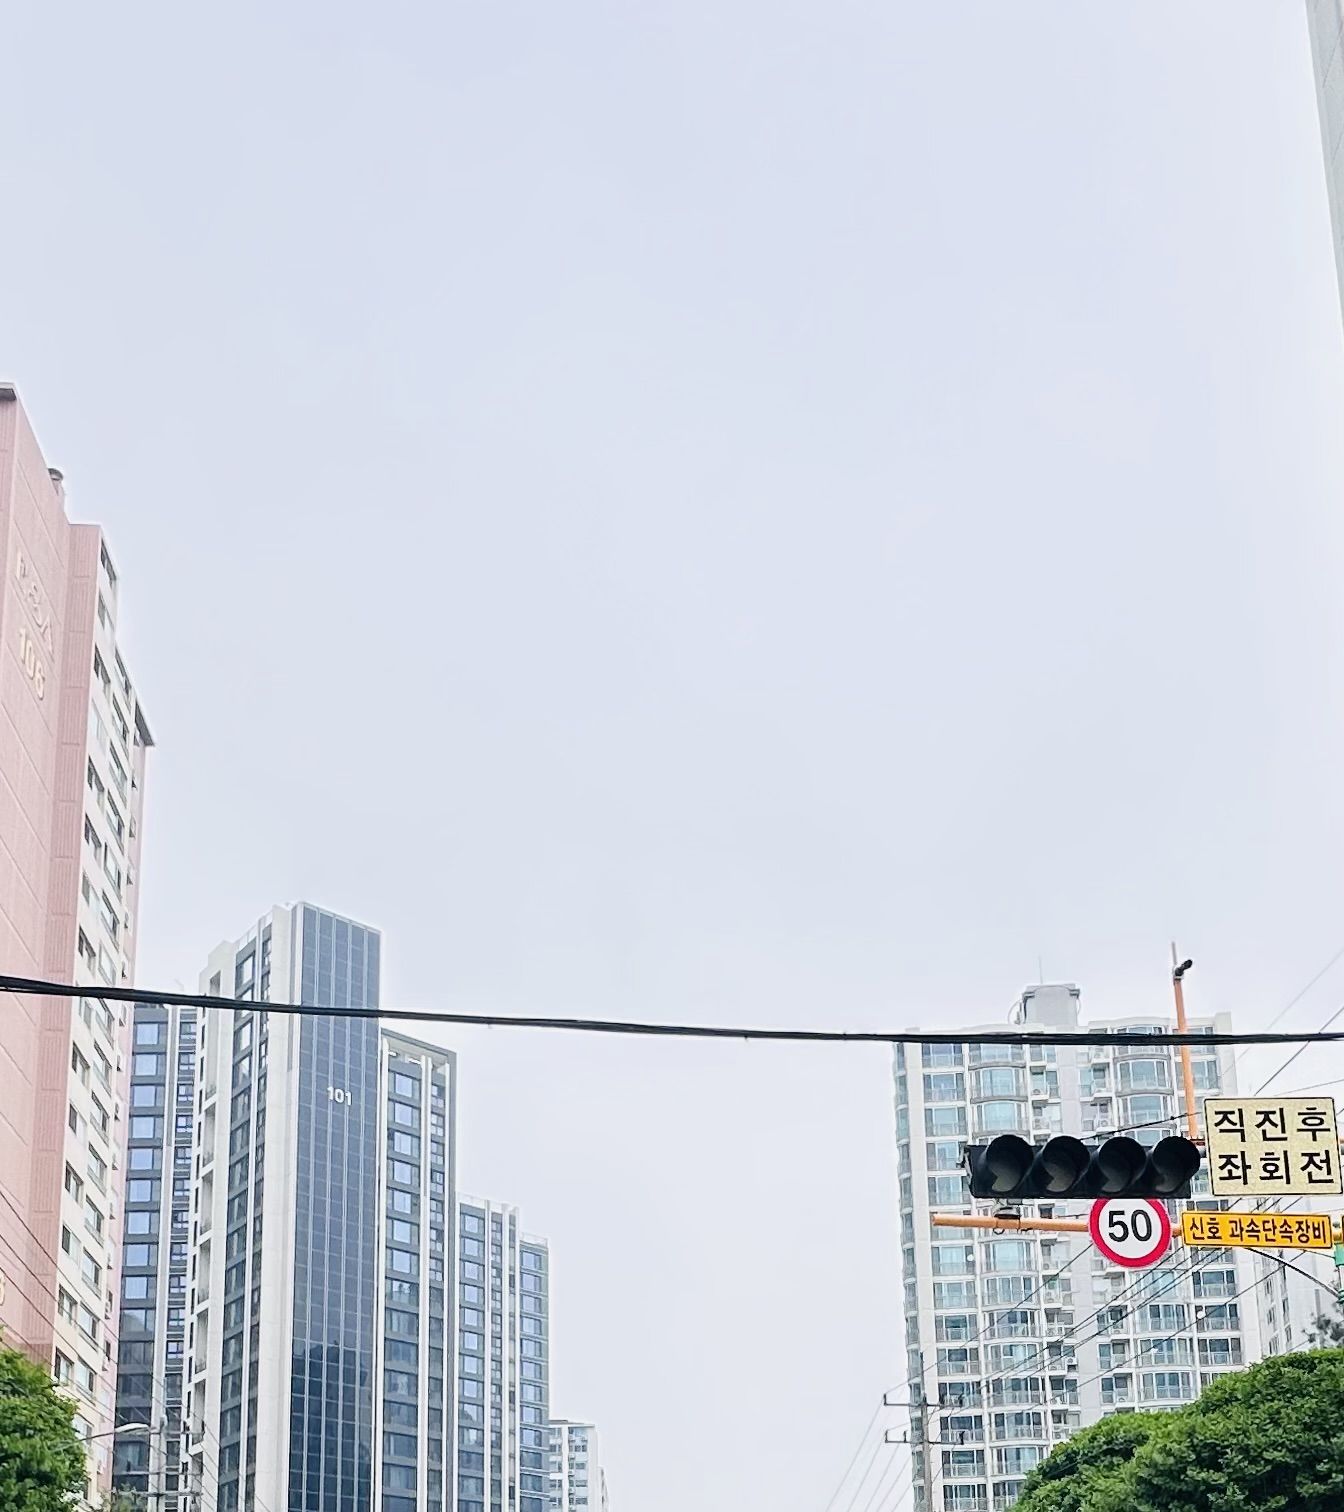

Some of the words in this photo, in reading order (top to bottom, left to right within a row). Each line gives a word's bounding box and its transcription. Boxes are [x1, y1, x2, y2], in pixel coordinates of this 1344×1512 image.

[326, 1085, 353, 1106] 101
[1213, 1106, 1332, 1143] 직진후
[1217, 1149, 1335, 1186] 좌회전
[1107, 1208, 1152, 1243] 50
[1189, 1216, 1223, 1241] 신호
[1228, 1217, 1327, 1245] 과속단속장비
